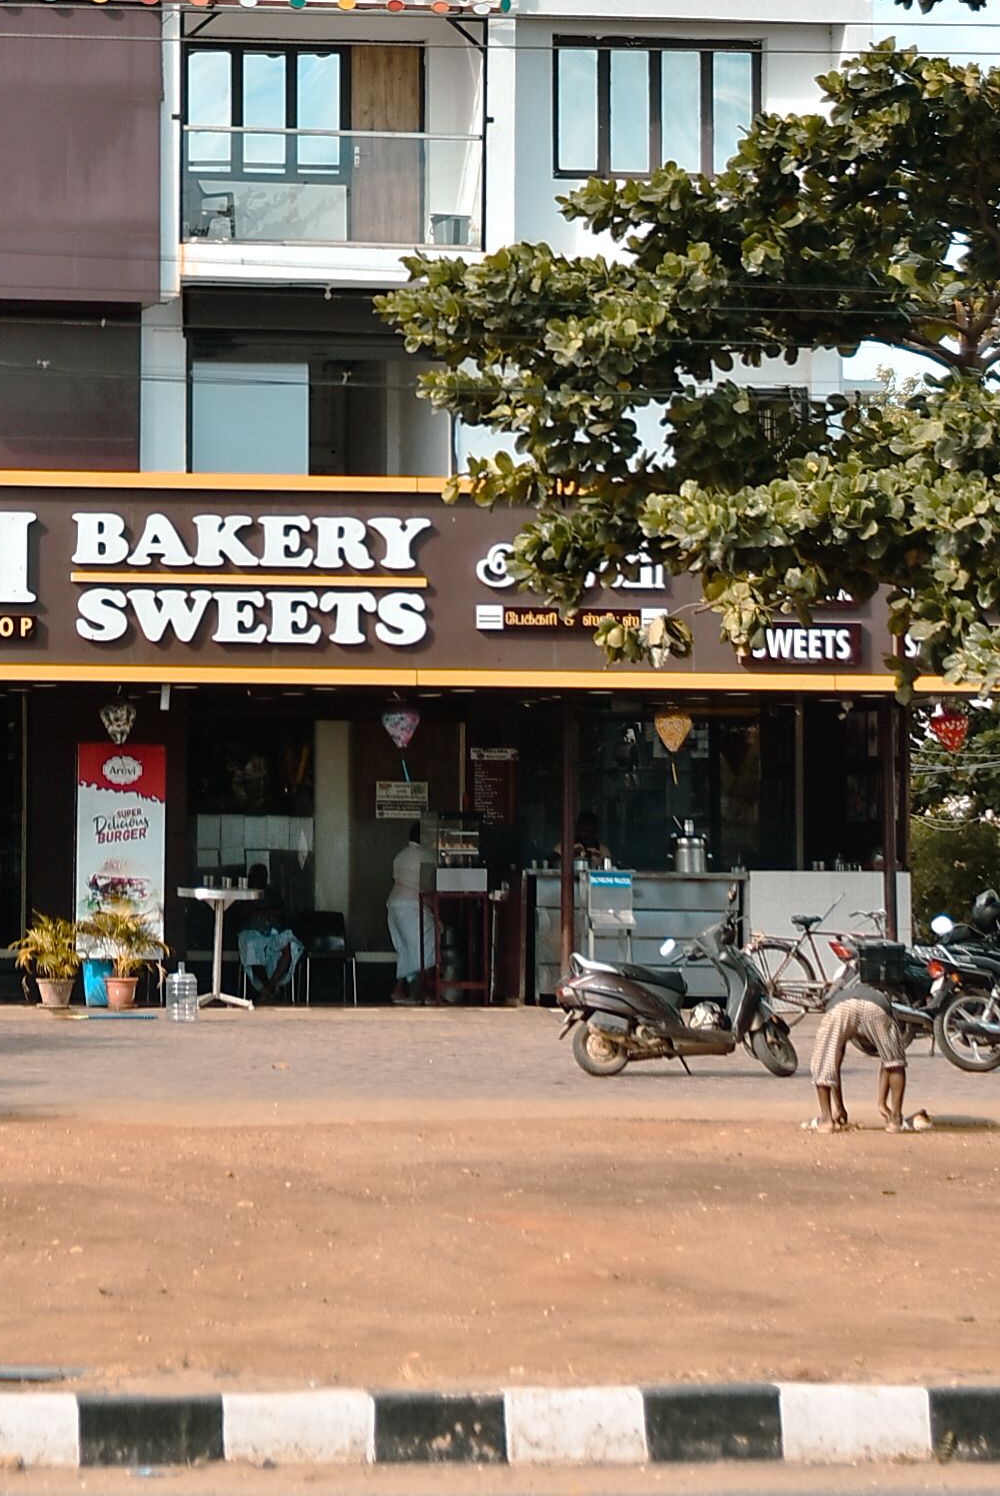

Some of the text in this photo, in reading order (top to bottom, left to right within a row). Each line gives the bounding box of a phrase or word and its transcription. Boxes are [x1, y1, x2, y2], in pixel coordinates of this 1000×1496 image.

[71, 511, 432, 571] BAKERY
[76, 587, 427, 647] SWEETS
[752, 629, 850, 659] WEETS
[93, 815, 149, 835] Delicious
[117, 808, 142, 819] SUPER
[97, 828, 147, 844] BURGER
